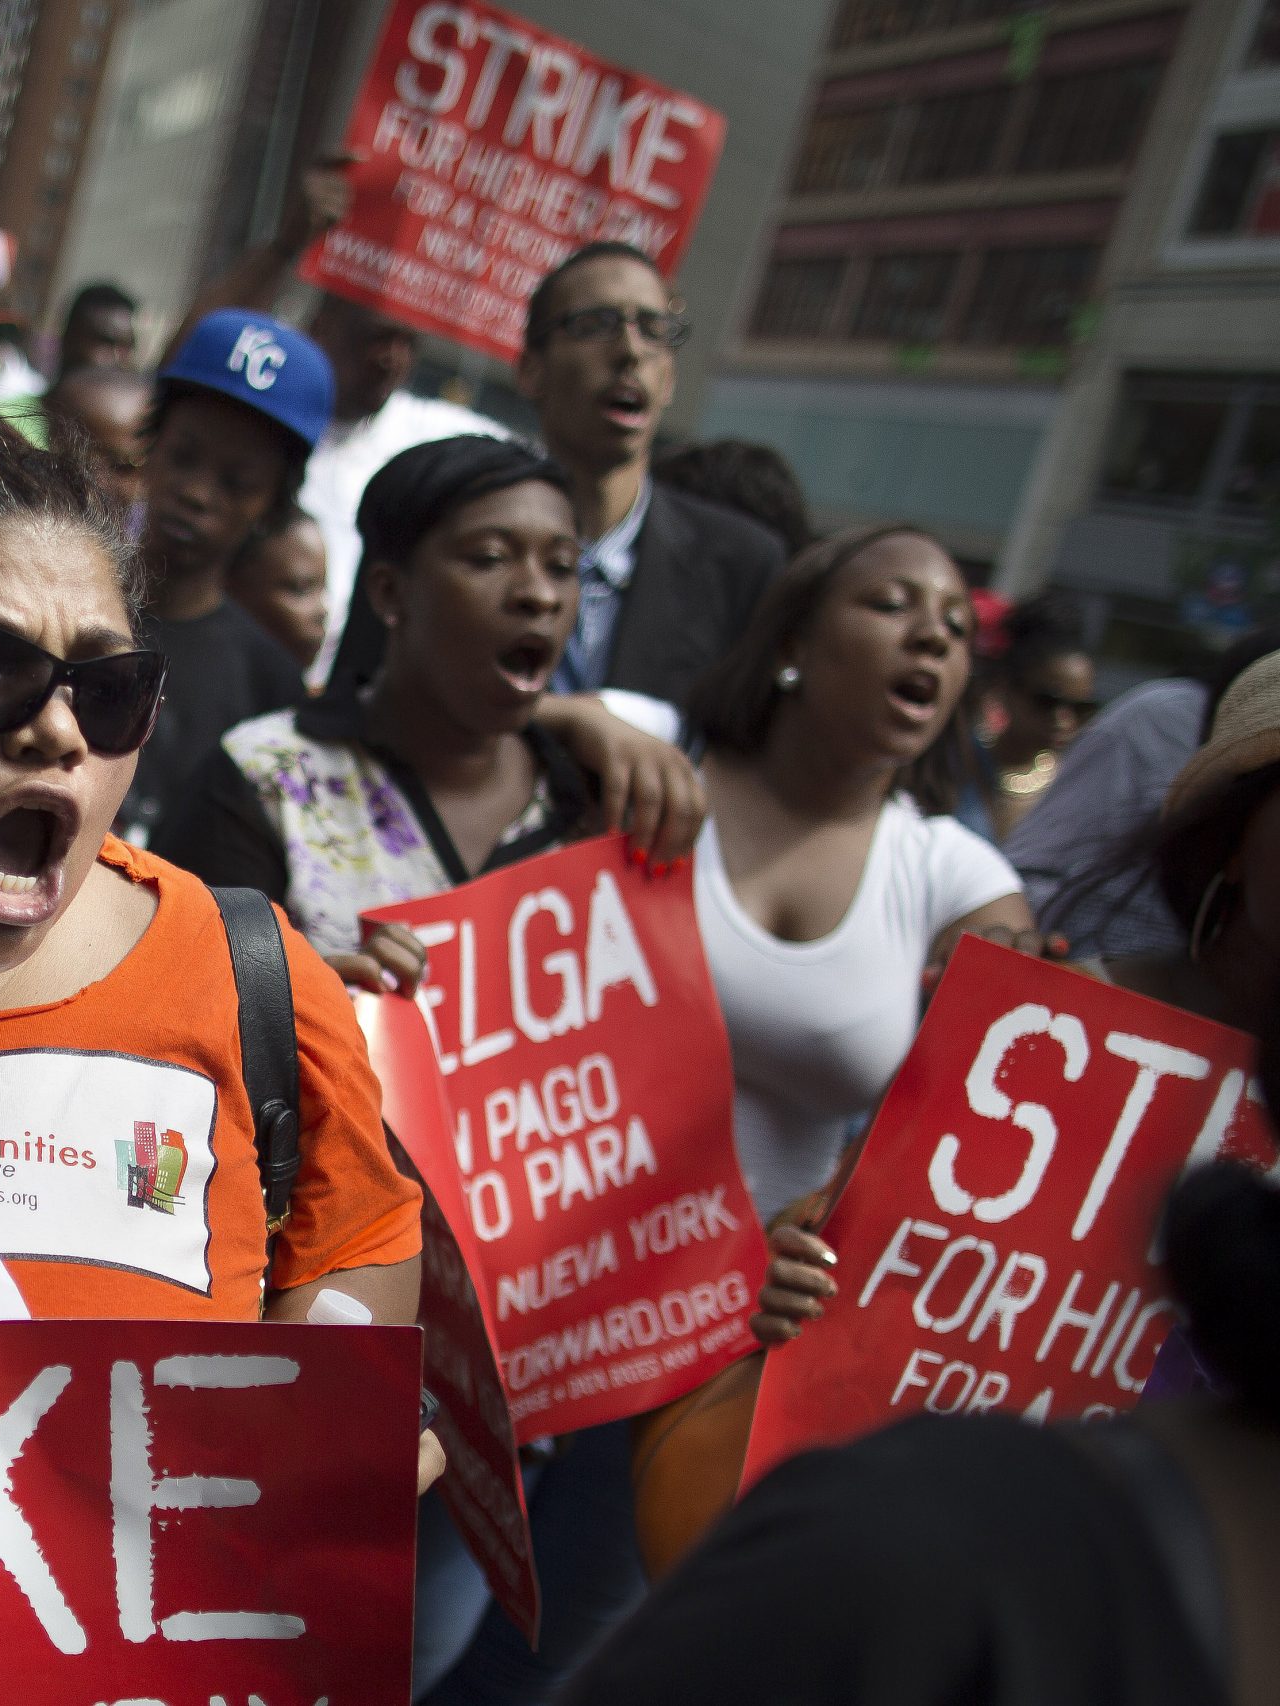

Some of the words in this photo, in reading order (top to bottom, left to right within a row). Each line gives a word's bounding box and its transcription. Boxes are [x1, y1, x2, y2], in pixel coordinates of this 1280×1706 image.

[394, 3, 706, 210] STRIKE
[372, 102, 468, 183] FOR
[455, 137, 610, 238] HIGHER
[227, 324, 287, 390] KC
[484, 1052, 619, 1161] PAGO
[524, 1115, 658, 1222] PARA
[497, 1230, 617, 1322] NUEVA
[629, 1185, 741, 1262] YORK
[857, 1217, 1048, 1351] FOR
[500, 1271, 751, 1391] ORWARD.ORG
[888, 1347, 1010, 1417] FOR
